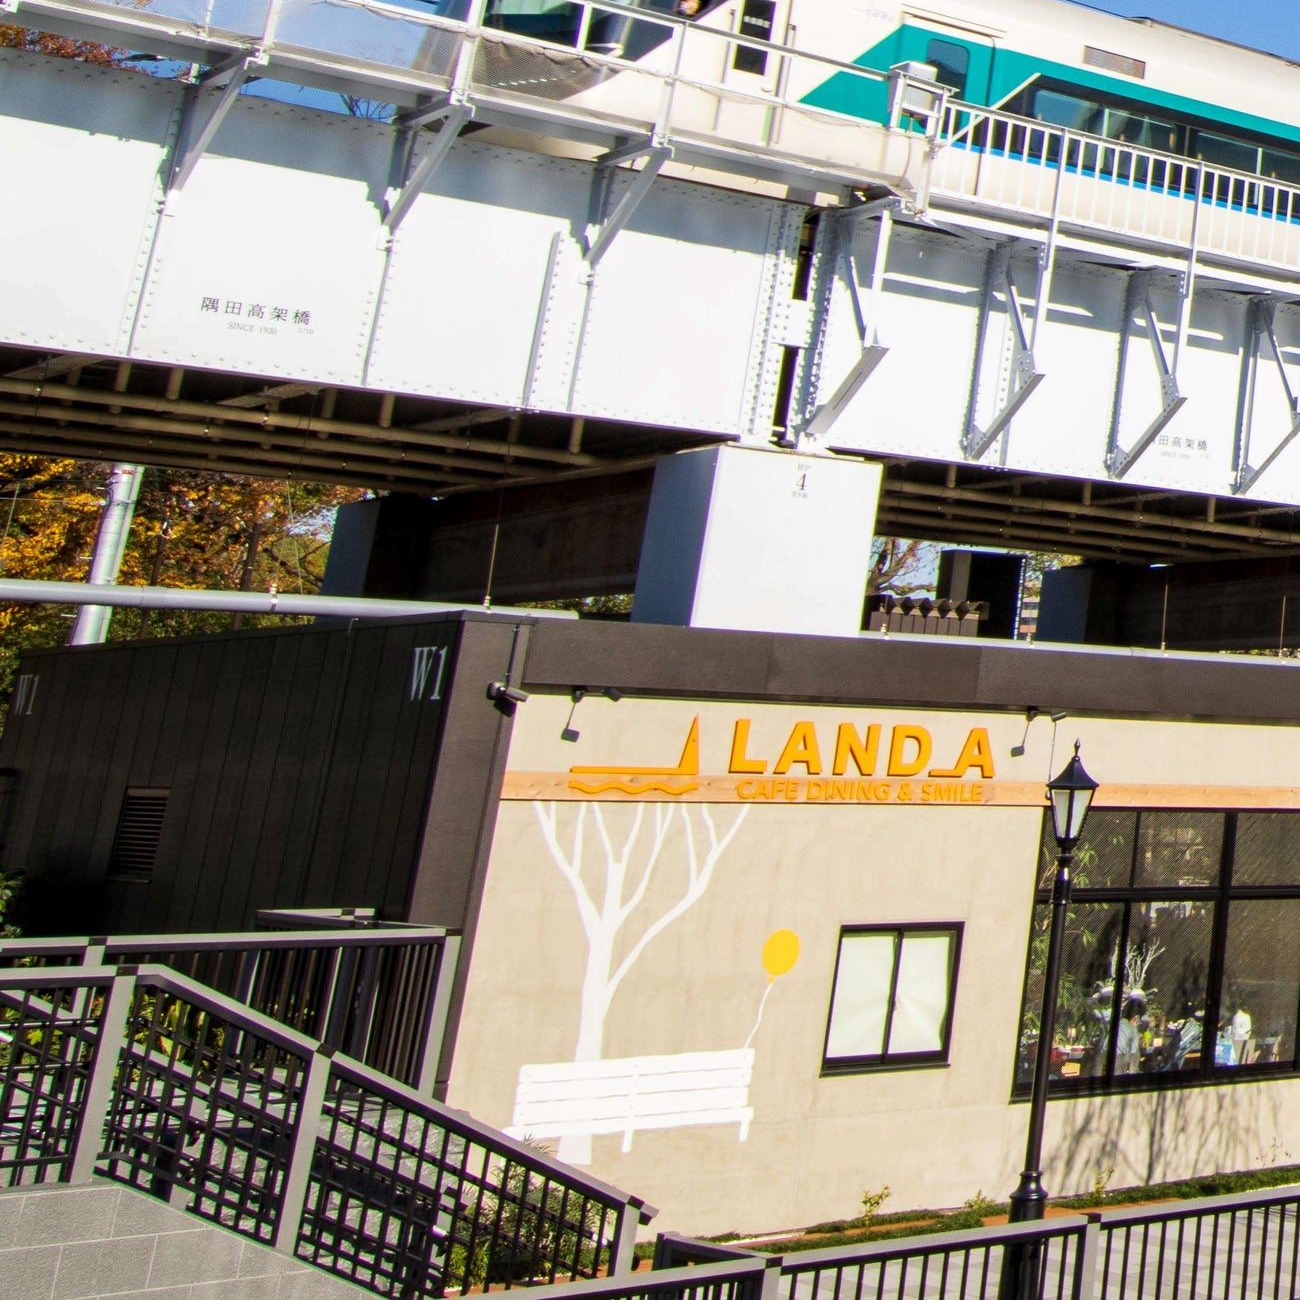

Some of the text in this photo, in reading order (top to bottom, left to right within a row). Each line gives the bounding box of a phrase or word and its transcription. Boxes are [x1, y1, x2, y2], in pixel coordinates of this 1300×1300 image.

[201, 296, 311, 325] 隅田高架橋
[227, 322, 255, 332] SINCE
[1152, 435, 1208, 451] 田高架橋
[795, 473, 808, 491] 4
[410, 645, 448, 701] W1
[14, 674, 39, 715] W1
[735, 779, 984, 803] CAFE DINING & SMILE
